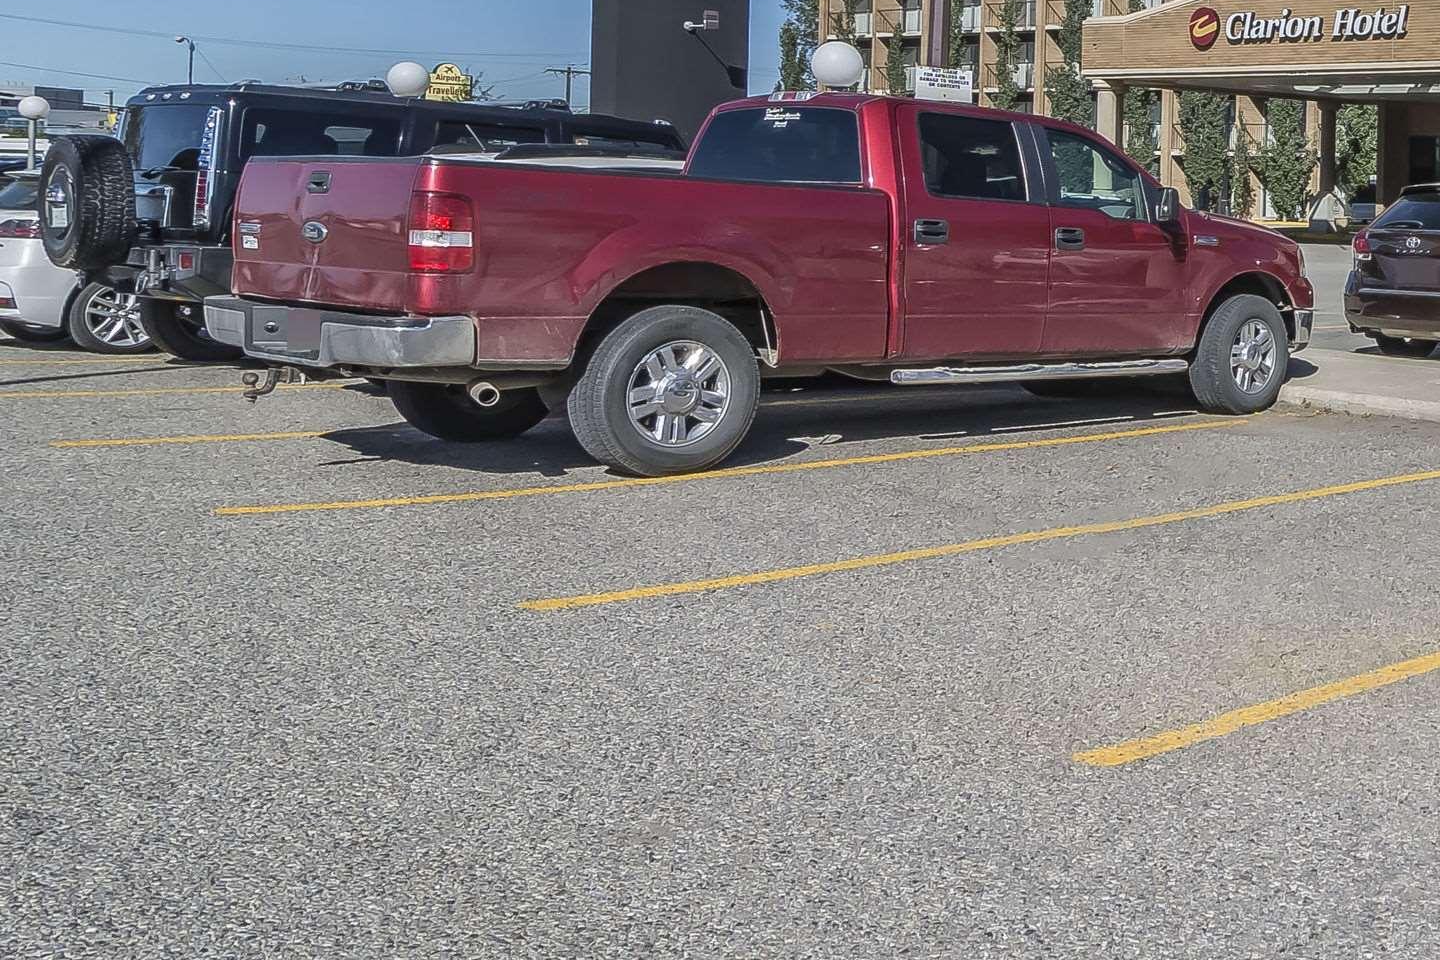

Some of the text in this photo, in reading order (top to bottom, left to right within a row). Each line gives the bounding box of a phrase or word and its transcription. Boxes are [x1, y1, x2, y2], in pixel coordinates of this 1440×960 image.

[1226, 4, 1409, 41] Clarion Hotel
[435, 73, 461, 82] Airport
